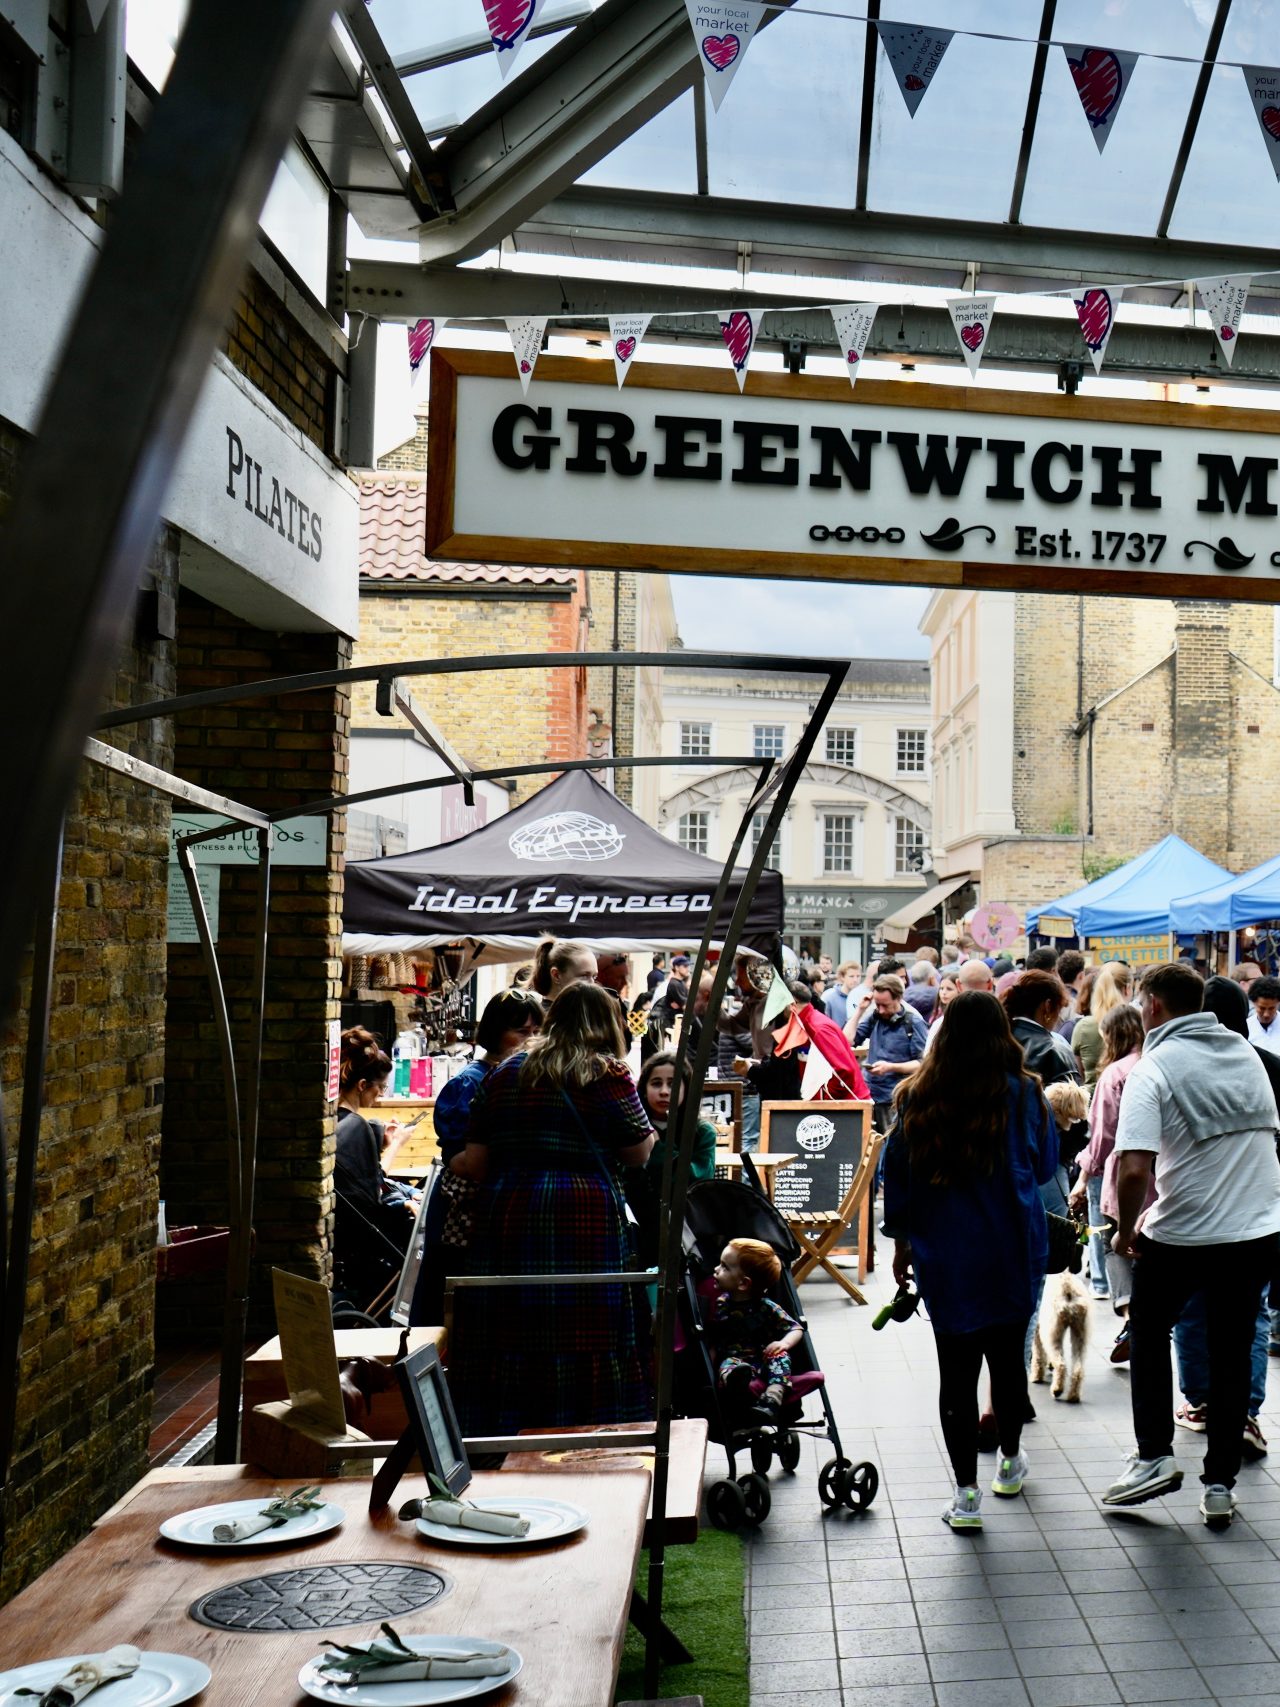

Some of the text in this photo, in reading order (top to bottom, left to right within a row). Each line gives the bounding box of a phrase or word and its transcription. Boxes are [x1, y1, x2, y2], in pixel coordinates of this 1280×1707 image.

[695, 16, 749, 33] market
[697, 5, 749, 19] your local
[911, 37, 932, 74] your local
[922, 40, 947, 78] market
[1254, 77, 1278, 86] your
[955, 312, 989, 322] market
[1222, 286, 1235, 323] your local
[1232, 288, 1246, 326] market
[529, 329, 543, 361] market
[613, 327, 643, 335] market
[857, 316, 873, 351] market
[492, 403, 1161, 508] GREENWICH
[226, 425, 323, 562] PILATES
[1014, 526, 1167, 563] Est. 1737
[408, 886, 713, 923] Ideal Espresso
